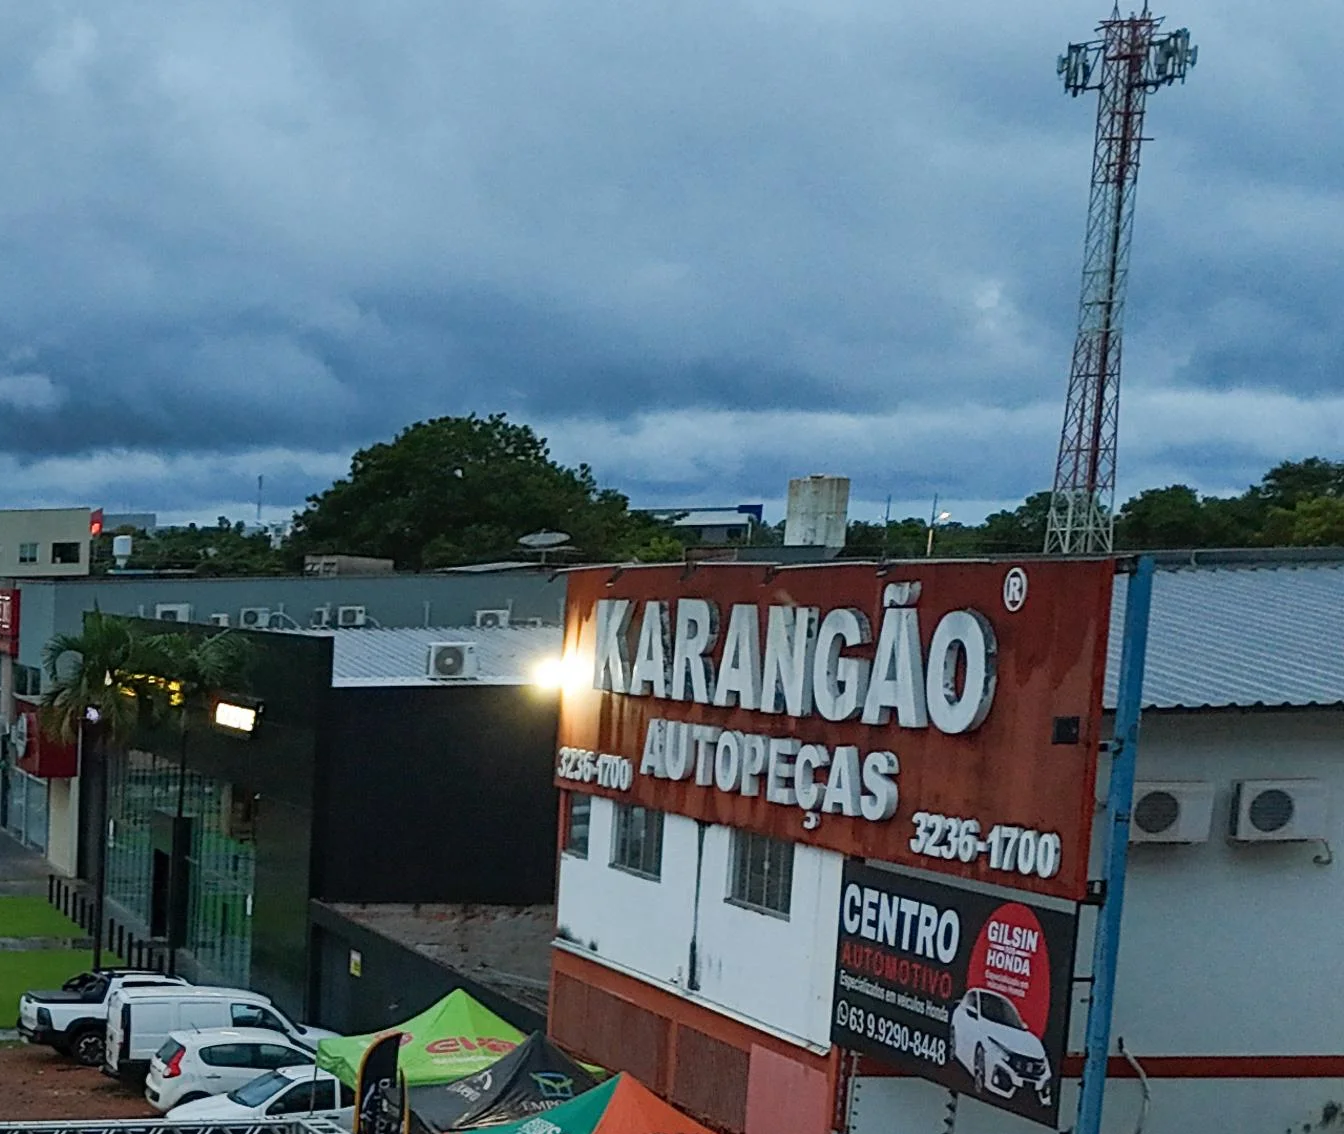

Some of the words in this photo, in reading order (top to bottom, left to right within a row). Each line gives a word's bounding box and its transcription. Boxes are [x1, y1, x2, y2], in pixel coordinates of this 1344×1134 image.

[593, 582, 998, 734] KARANGÃO
[558, 747, 633, 791] 3236-1700
[640, 718, 900, 829] AUTOPEÇAS
[910, 812, 1061, 878] 3236-1700
[843, 883, 960, 964] CENTRO
[988, 921, 1038, 952] GILSIN
[841, 942, 952, 998] AUTOMOTIVO
[986, 949, 1030, 976] HONDA
[885, 989, 896, 1004] em
[925, 999, 949, 1023] Honda
[849, 1007, 864, 1034] 63
[867, 1012, 946, 1066] 9.9290-8448
